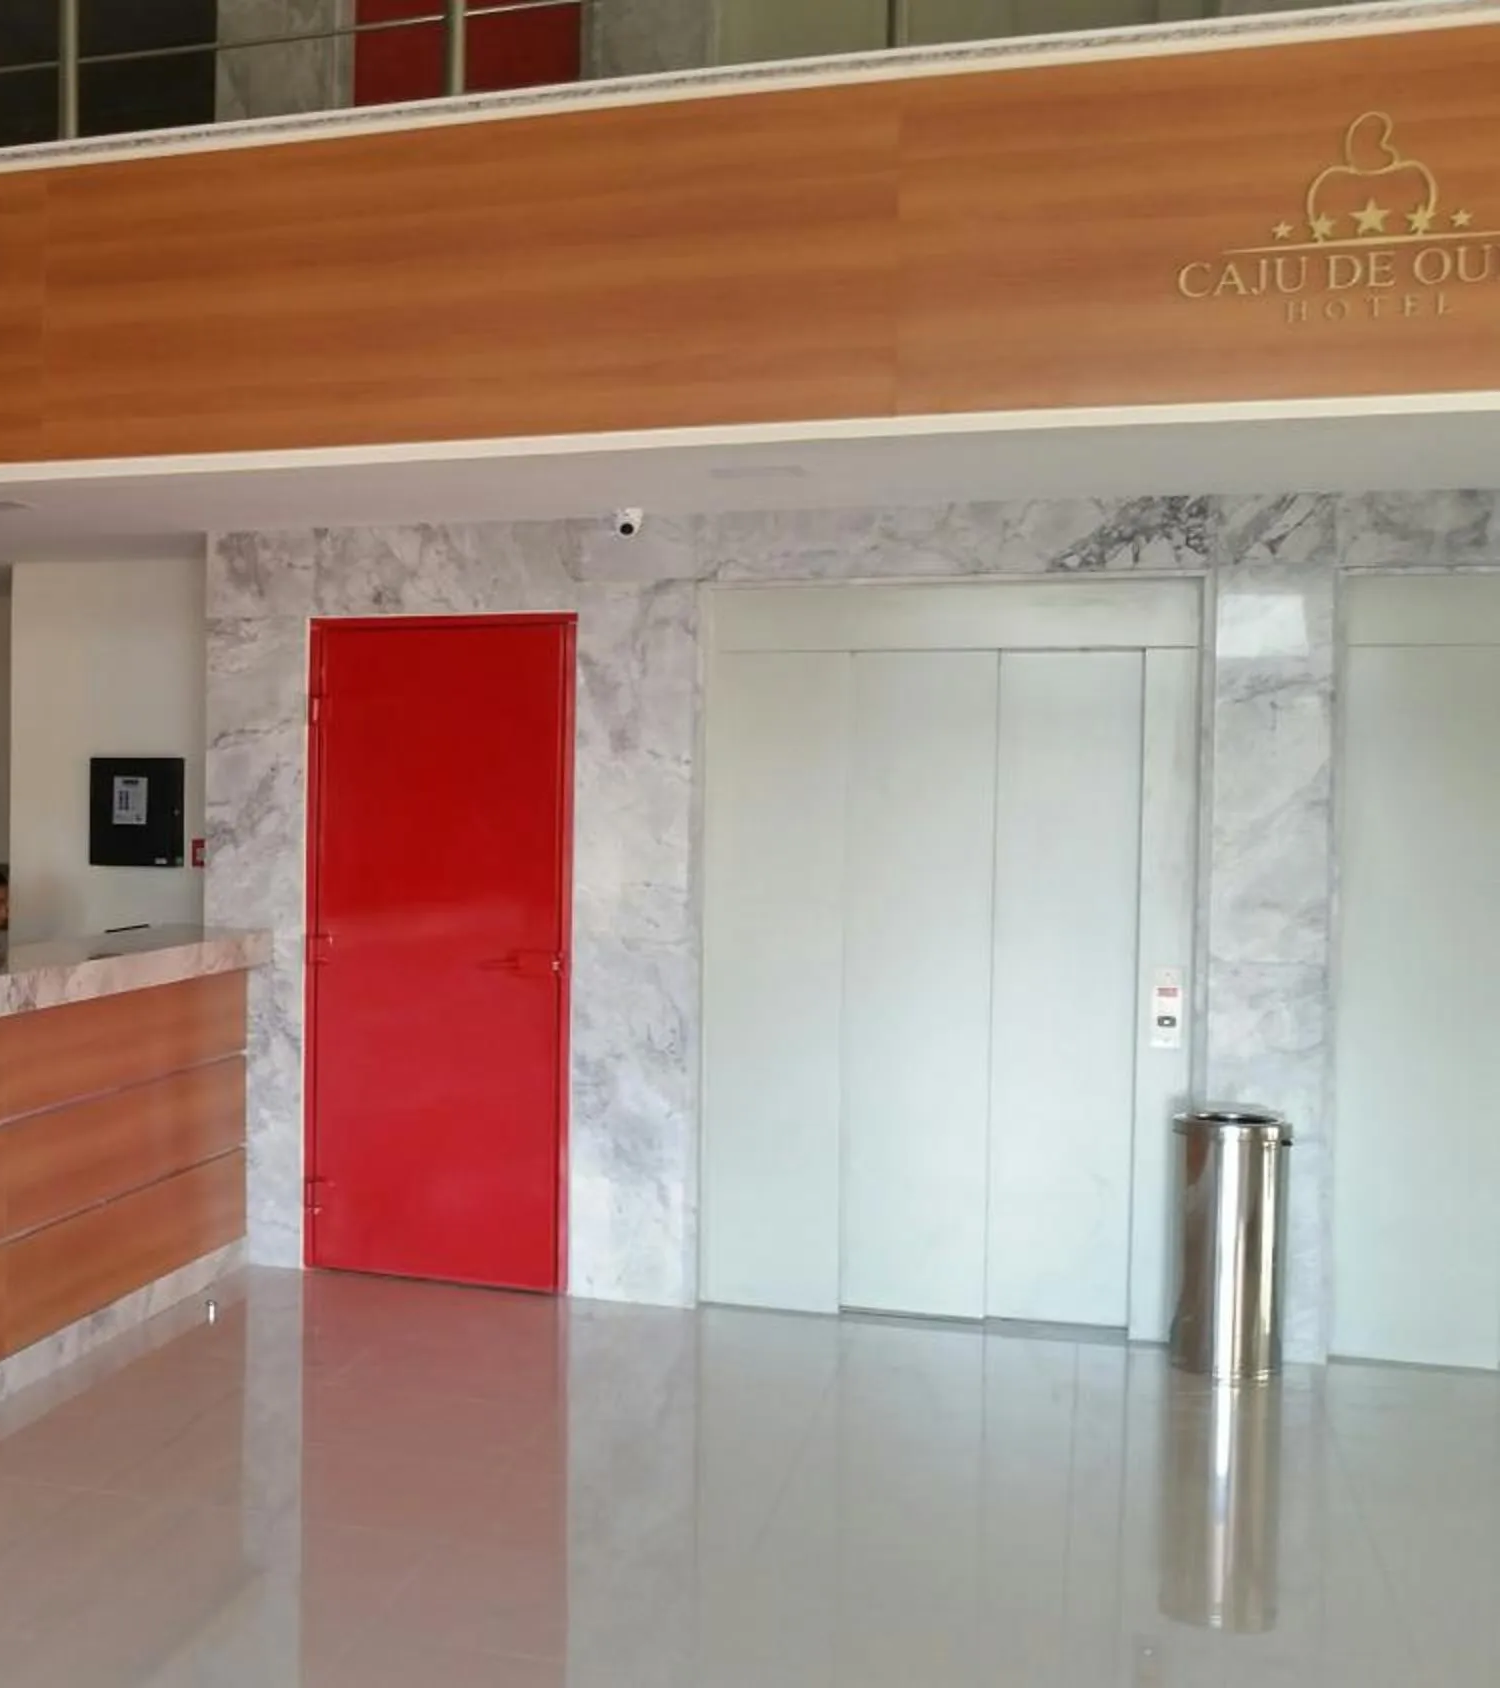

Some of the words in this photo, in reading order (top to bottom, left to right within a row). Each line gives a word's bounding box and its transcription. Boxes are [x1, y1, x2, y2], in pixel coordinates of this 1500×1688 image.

[1177, 254, 1308, 298] CAJU
[1325, 251, 1397, 291] DE
[1413, 244, 1500, 286] OU
[1285, 293, 1451, 324] HOTEL
